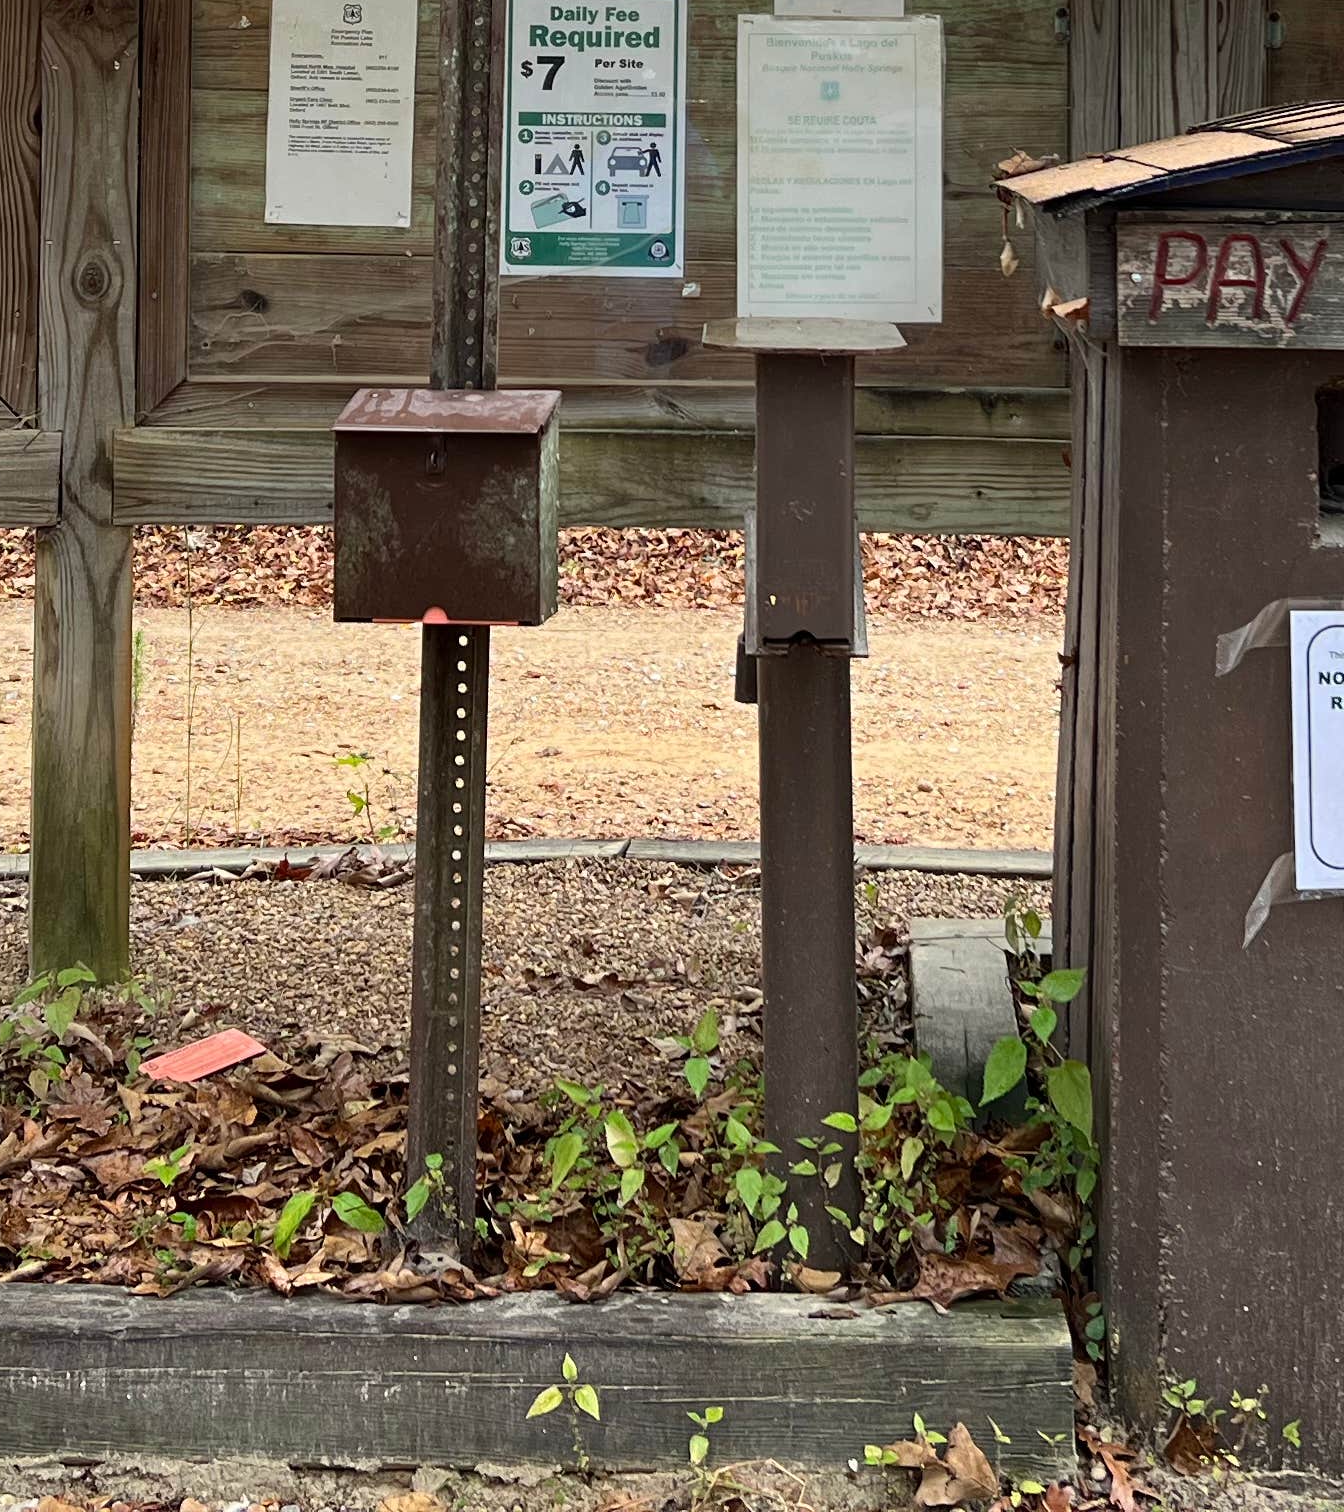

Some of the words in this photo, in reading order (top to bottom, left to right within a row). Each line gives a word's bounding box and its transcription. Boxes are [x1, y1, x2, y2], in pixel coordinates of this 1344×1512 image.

[549, 6, 599, 24] Daily
[605, 7, 640, 22] Fee
[529, 25, 661, 53] Required
[520, 55, 566, 91] $7
[594, 58, 616, 69] Per
[618, 58, 644, 69] Site
[541, 114, 643, 126] INSTRUCTIONS
[1147, 230, 1328, 329] PAY
[1318, 672, 1344, 685] NO
